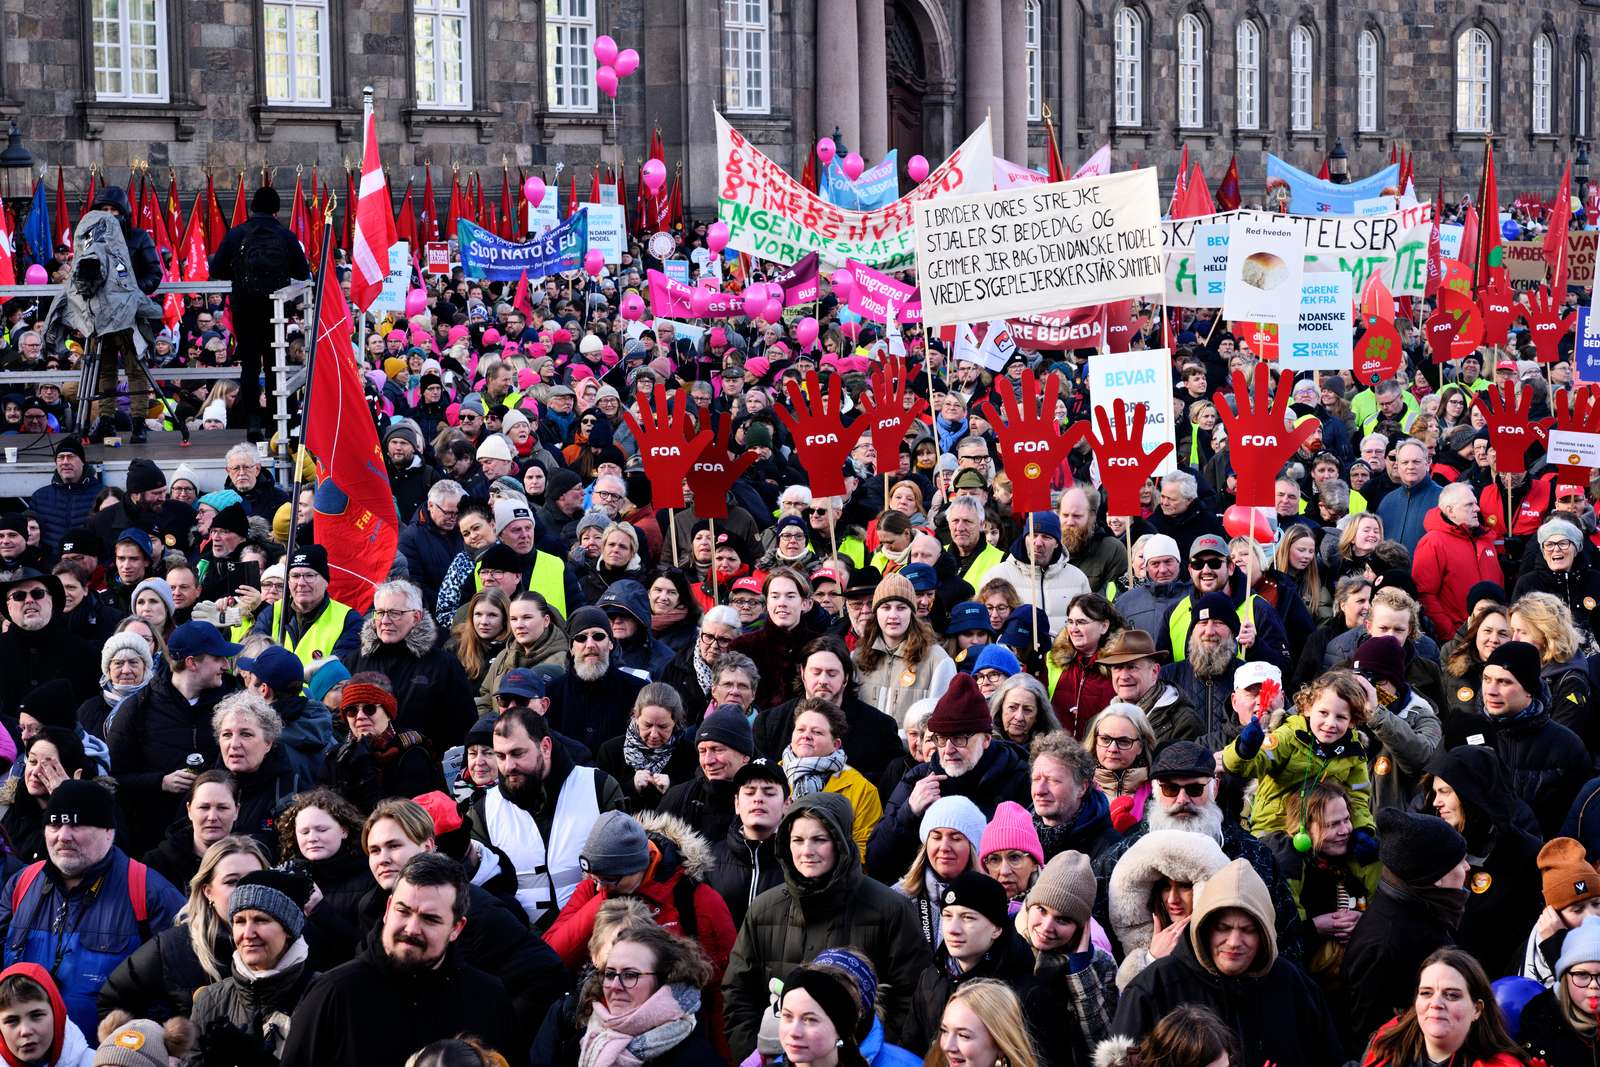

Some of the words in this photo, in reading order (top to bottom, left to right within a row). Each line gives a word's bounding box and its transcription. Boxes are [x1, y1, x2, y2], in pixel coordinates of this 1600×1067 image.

[925, 210, 932, 228] I
[935, 204, 980, 227] BRYDER
[984, 199, 1027, 219] VORES
[1033, 186, 1102, 212] STREJKE
[717, 196, 801, 243] INGEN
[807, 231, 910, 255] AFSKAFF
[927, 227, 987, 252] STJÆLER
[992, 224, 1009, 244] ST.
[1014, 214, 1083, 243] BEDEDAG
[1092, 209, 1114, 230] OG
[1246, 227, 1261, 236] Red
[1263, 228, 1292, 237] hveden
[1207, 236, 1229, 246] BEV
[470, 241, 498, 263] Stop
[501, 244, 542, 260] NATO
[545, 240, 557, 255] &
[559, 232, 576, 251] EU
[928, 254, 982, 279] GEMMER
[985, 252, 1011, 272] JER
[1012, 247, 1038, 267] BAG
[1118, 255, 1161, 279] SAMMEN
[855, 268, 902, 302] Fingrene
[798, 287, 817, 300] BUP
[1318, 295, 1336, 304] FRA
[1490, 304, 1509, 313] FOA
[906, 309, 923, 319] BU
[1307, 312, 1346, 321] DANSKE
[1037, 321, 1103, 341] BEDEDA
[1110, 325, 1129, 333] FOA
[1298, 323, 1333, 331] MODEL
[1433, 323, 1452, 333] FOA
[1536, 323, 1557, 331] FOA
[1362, 360, 1381, 370] dbio
[1105, 368, 1155, 388] BEVAR
[879, 417, 901, 429] FOA
[1497, 426, 1525, 435] FOA
[1533, 425, 1546, 439] FOA
[805, 433, 839, 447] FOA
[1242, 435, 1278, 447] FOA
[1014, 439, 1050, 453] FOA
[651, 447, 681, 457] FOA
[1108, 457, 1139, 467] FOA
[694, 463, 724, 473] FOA
[356, 510, 373, 530] FRI
[64, 543, 73, 551] 3F
[294, 554, 307, 563] 3F
[50, 814, 78, 824] FBI
